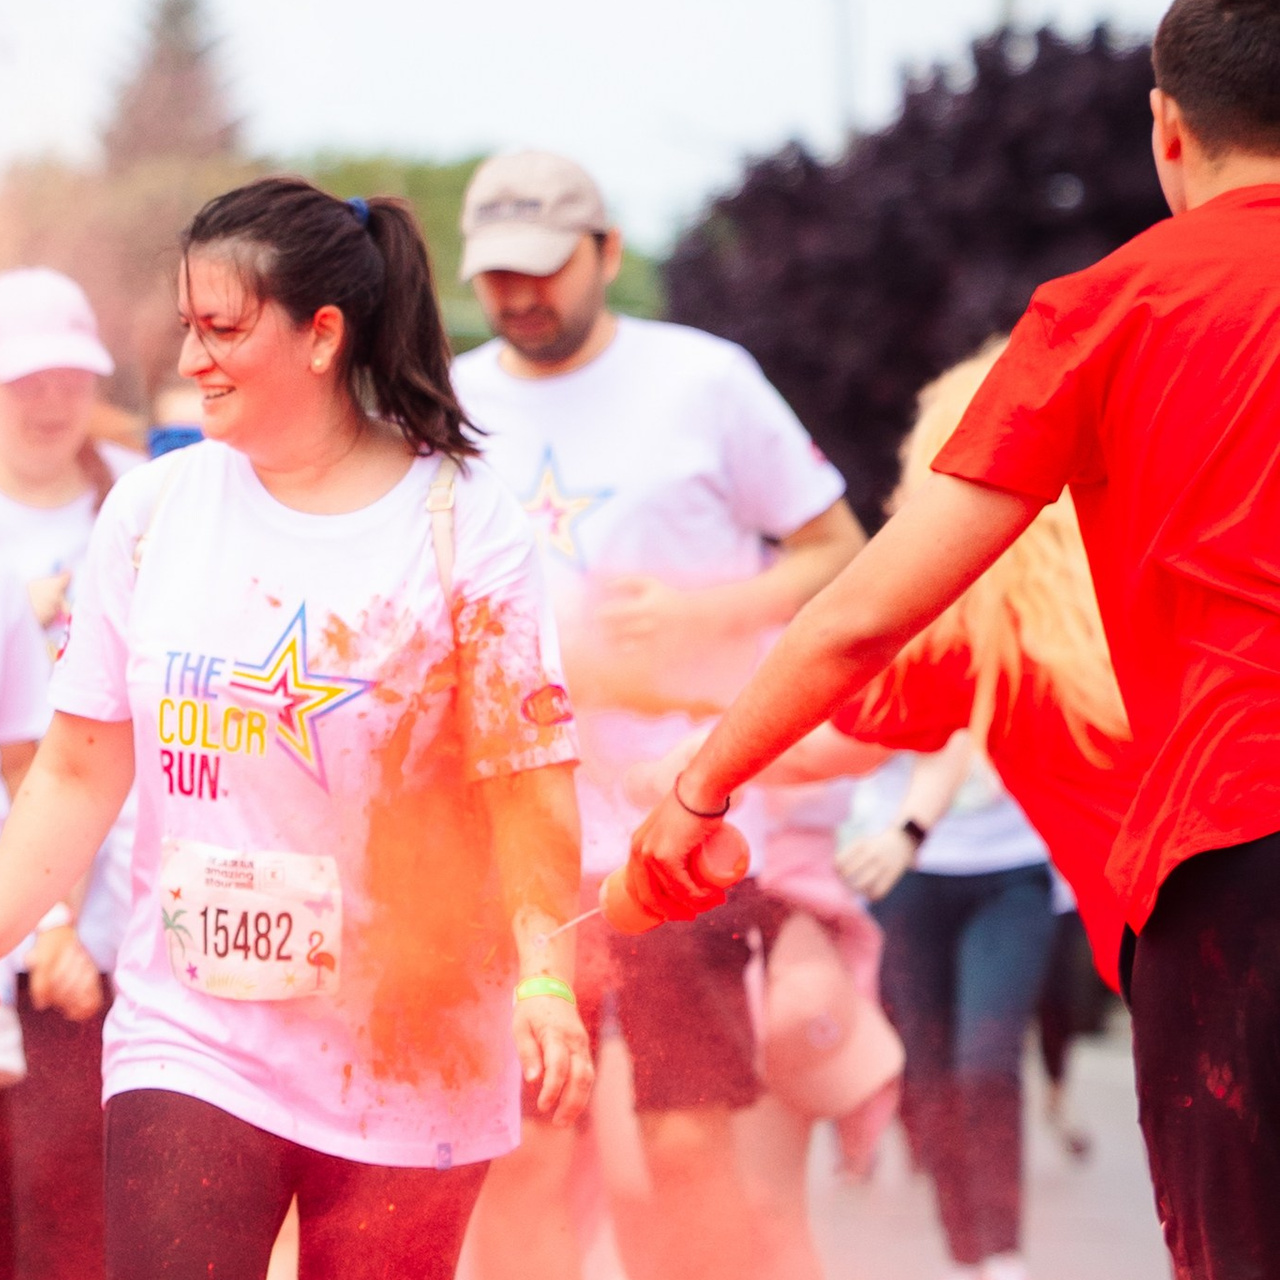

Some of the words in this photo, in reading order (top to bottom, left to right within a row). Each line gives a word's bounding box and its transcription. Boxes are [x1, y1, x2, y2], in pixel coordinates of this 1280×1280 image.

[164, 651, 226, 700] THE
[158, 697, 268, 756] COLOR
[198, 904, 293, 962] 15482
